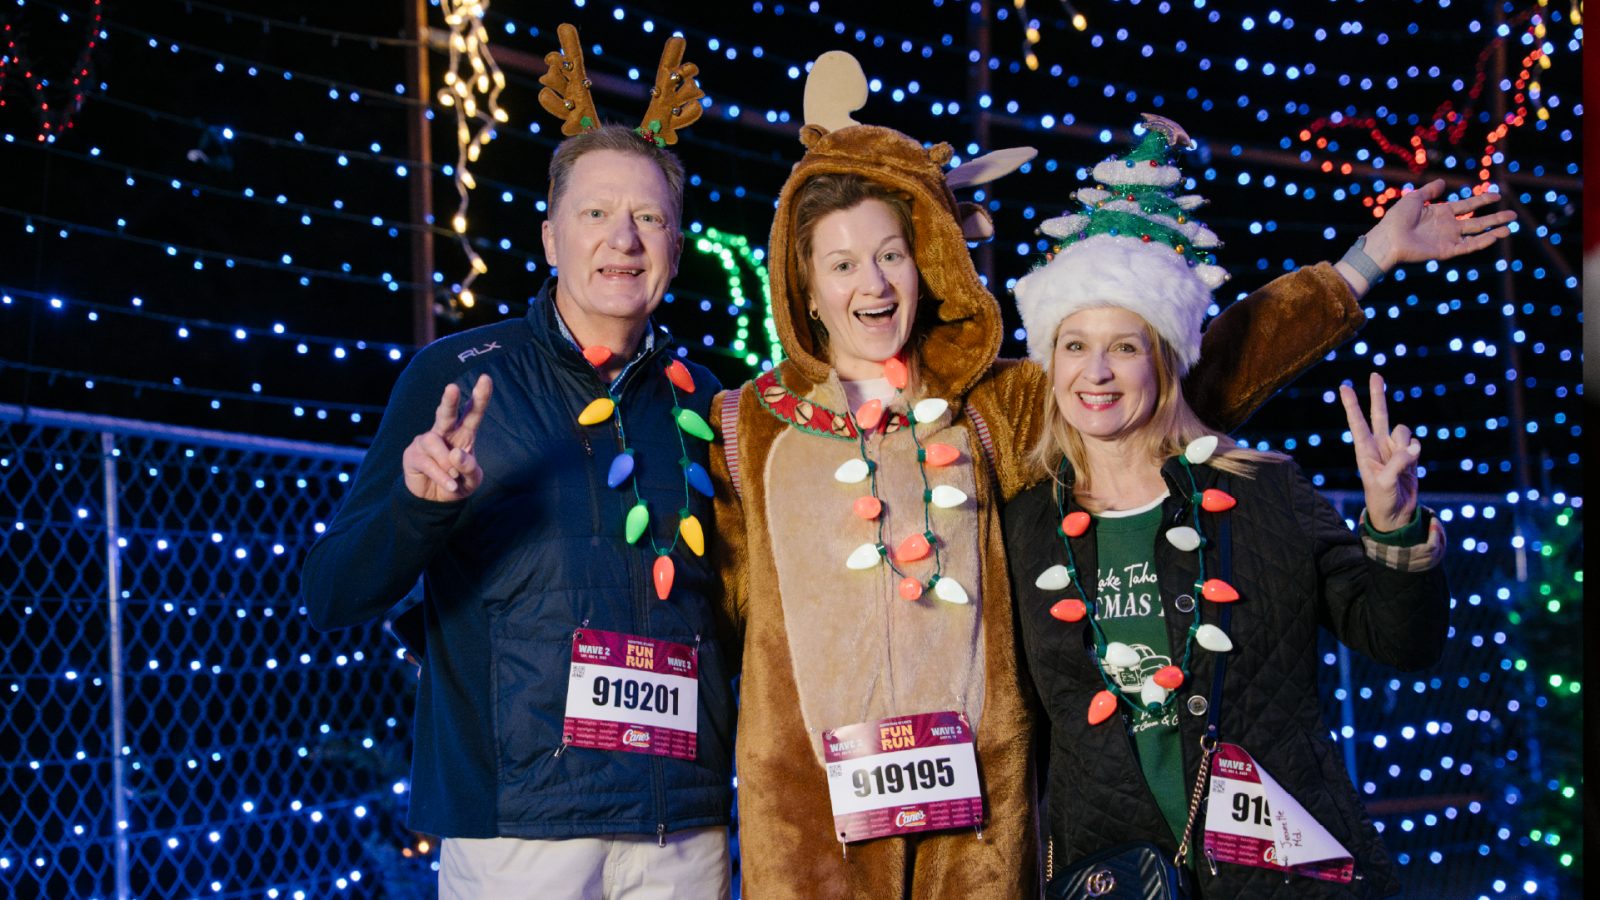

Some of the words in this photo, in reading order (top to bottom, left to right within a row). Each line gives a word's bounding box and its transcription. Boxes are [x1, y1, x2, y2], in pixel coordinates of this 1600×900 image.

[457, 341, 501, 362] RLX
[578, 645, 604, 655] WAVE
[604, 648, 611, 656] 2
[628, 644, 654, 658] FUN
[626, 656, 654, 670] RUN
[668, 657, 687, 669] WAVE
[686, 661, 692, 670] 2
[592, 675, 679, 716] 919201
[880, 725, 913, 739] FUN
[930, 727, 956, 737] WAVE
[830, 742, 855, 752] WAVE
[882, 736, 916, 751] RUN
[1218, 758, 1245, 771] WAVE
[1246, 764, 1252, 772] 2
[852, 757, 955, 798] 919195
